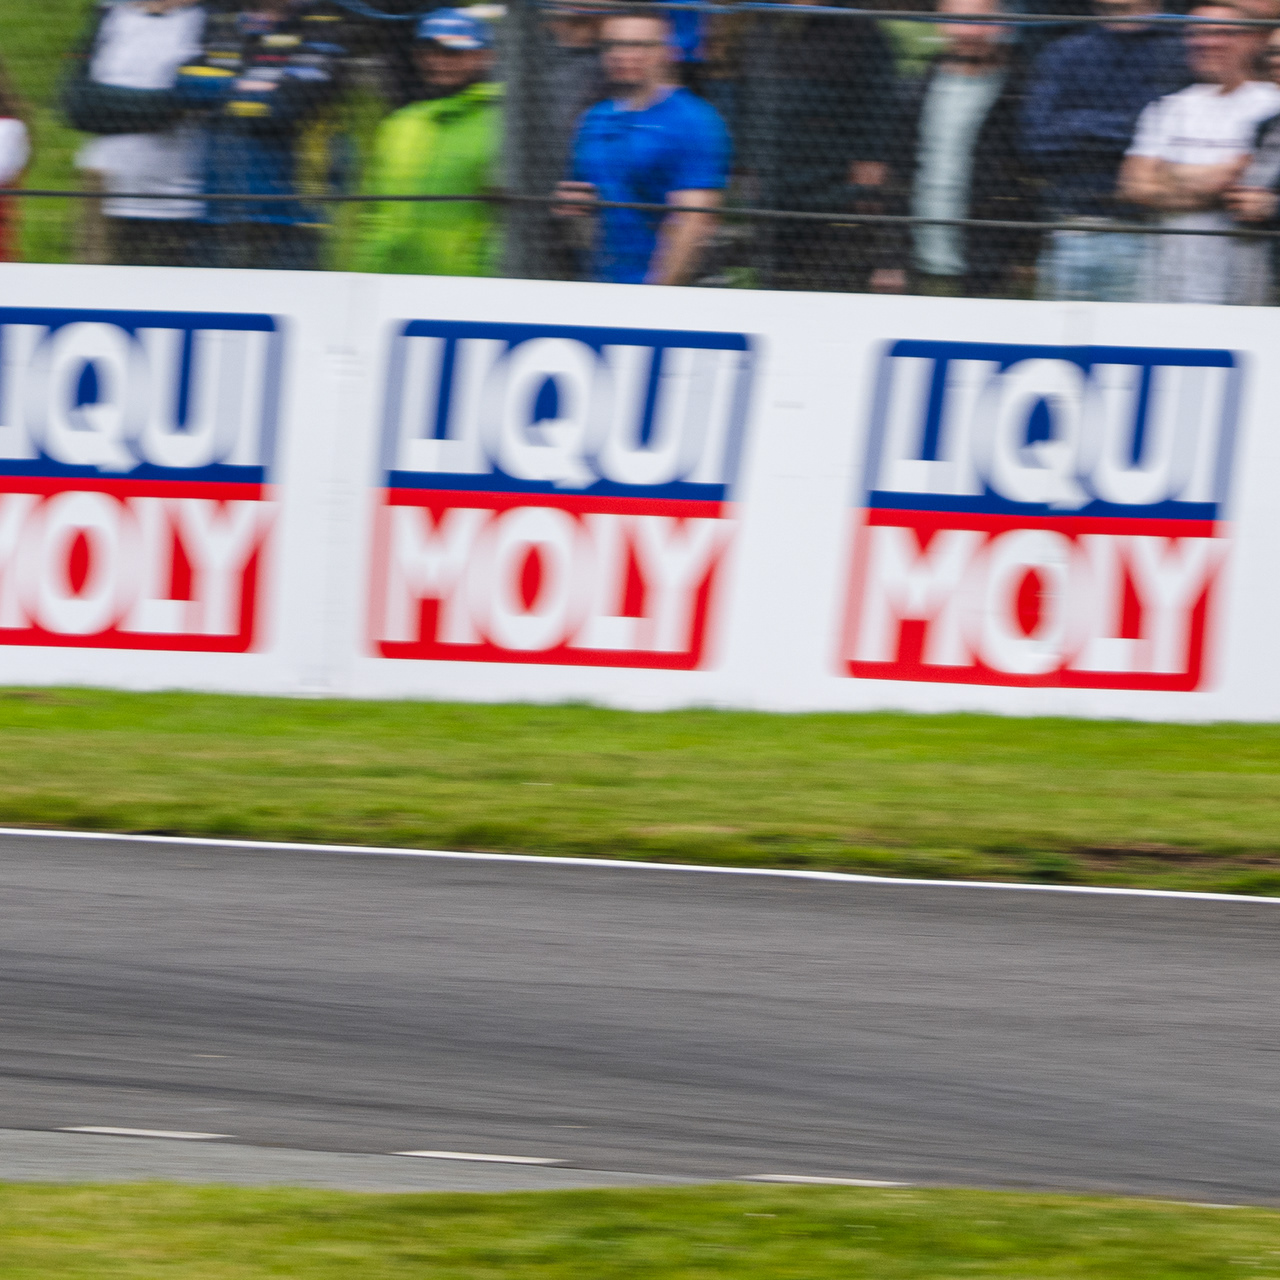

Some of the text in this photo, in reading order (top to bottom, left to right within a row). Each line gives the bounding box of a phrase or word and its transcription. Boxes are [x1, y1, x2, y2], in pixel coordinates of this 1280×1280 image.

[400, 338, 745, 488] LIQUI
[886, 358, 1232, 509] LIQUI
[378, 506, 740, 653] MOLY
[861, 526, 1235, 677] MOLY
